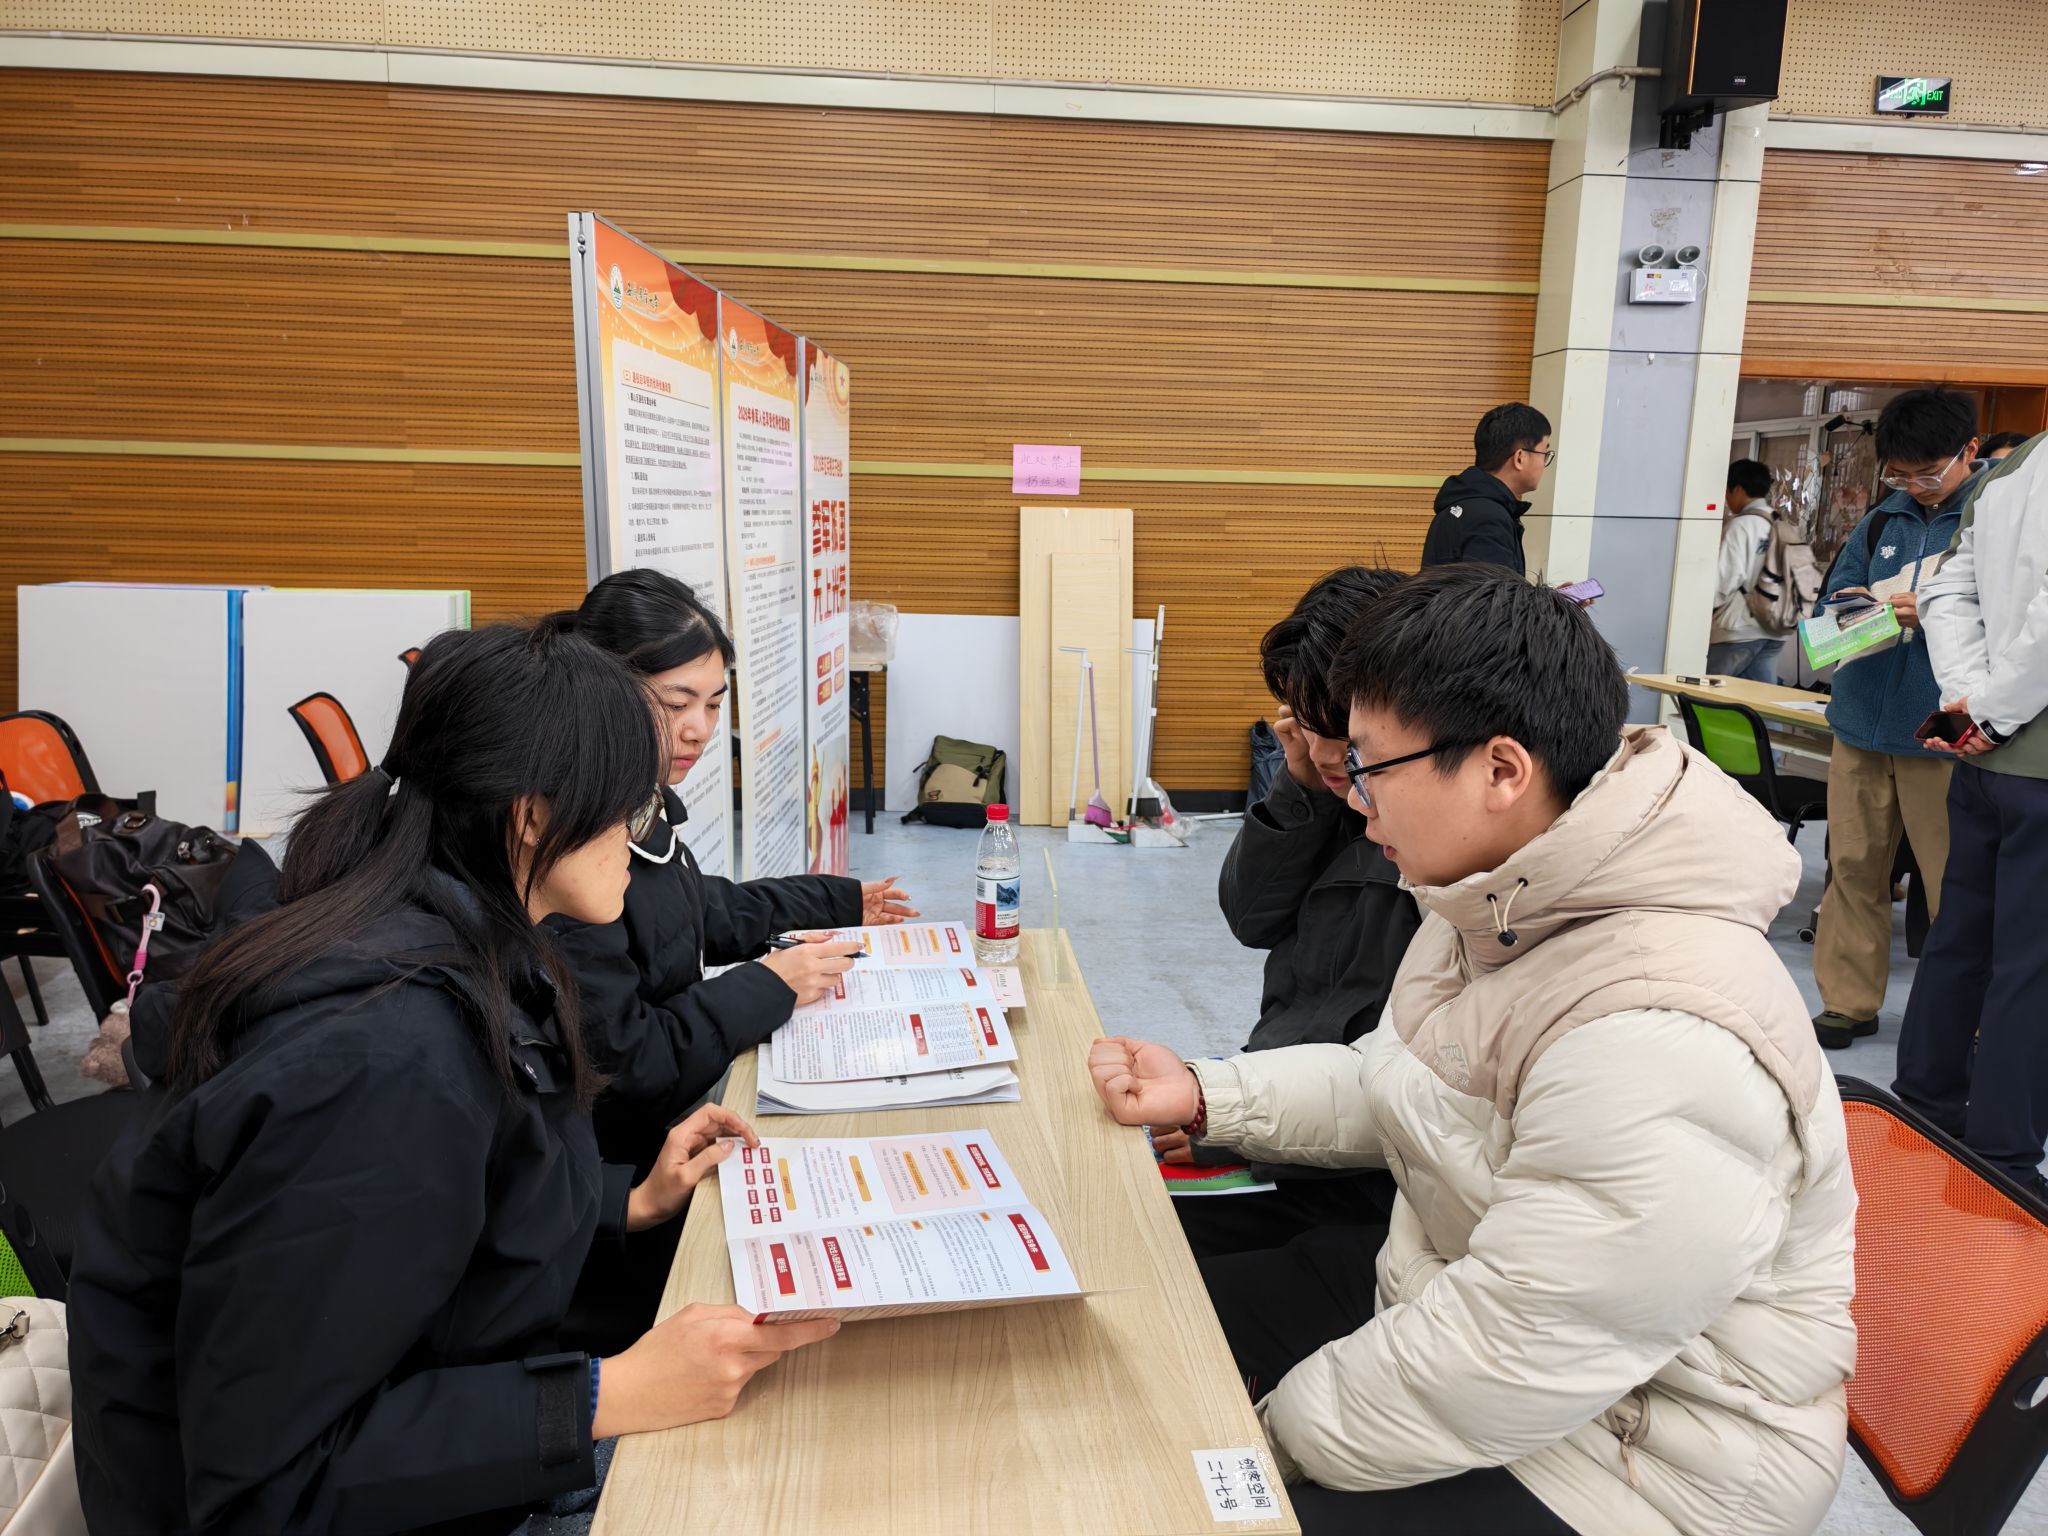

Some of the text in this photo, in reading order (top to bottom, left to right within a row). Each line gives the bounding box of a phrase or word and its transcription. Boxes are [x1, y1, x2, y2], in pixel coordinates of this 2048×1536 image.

[1927, 90, 1944, 101] EXIT
[1021, 452, 1078, 470] 此处禁止
[812, 500, 846, 557] 参军报国
[813, 562, 846, 625] 无上光荣
[1207, 1460, 1238, 1510] 二十七号
[1238, 1457, 1271, 1508] 创客空间
